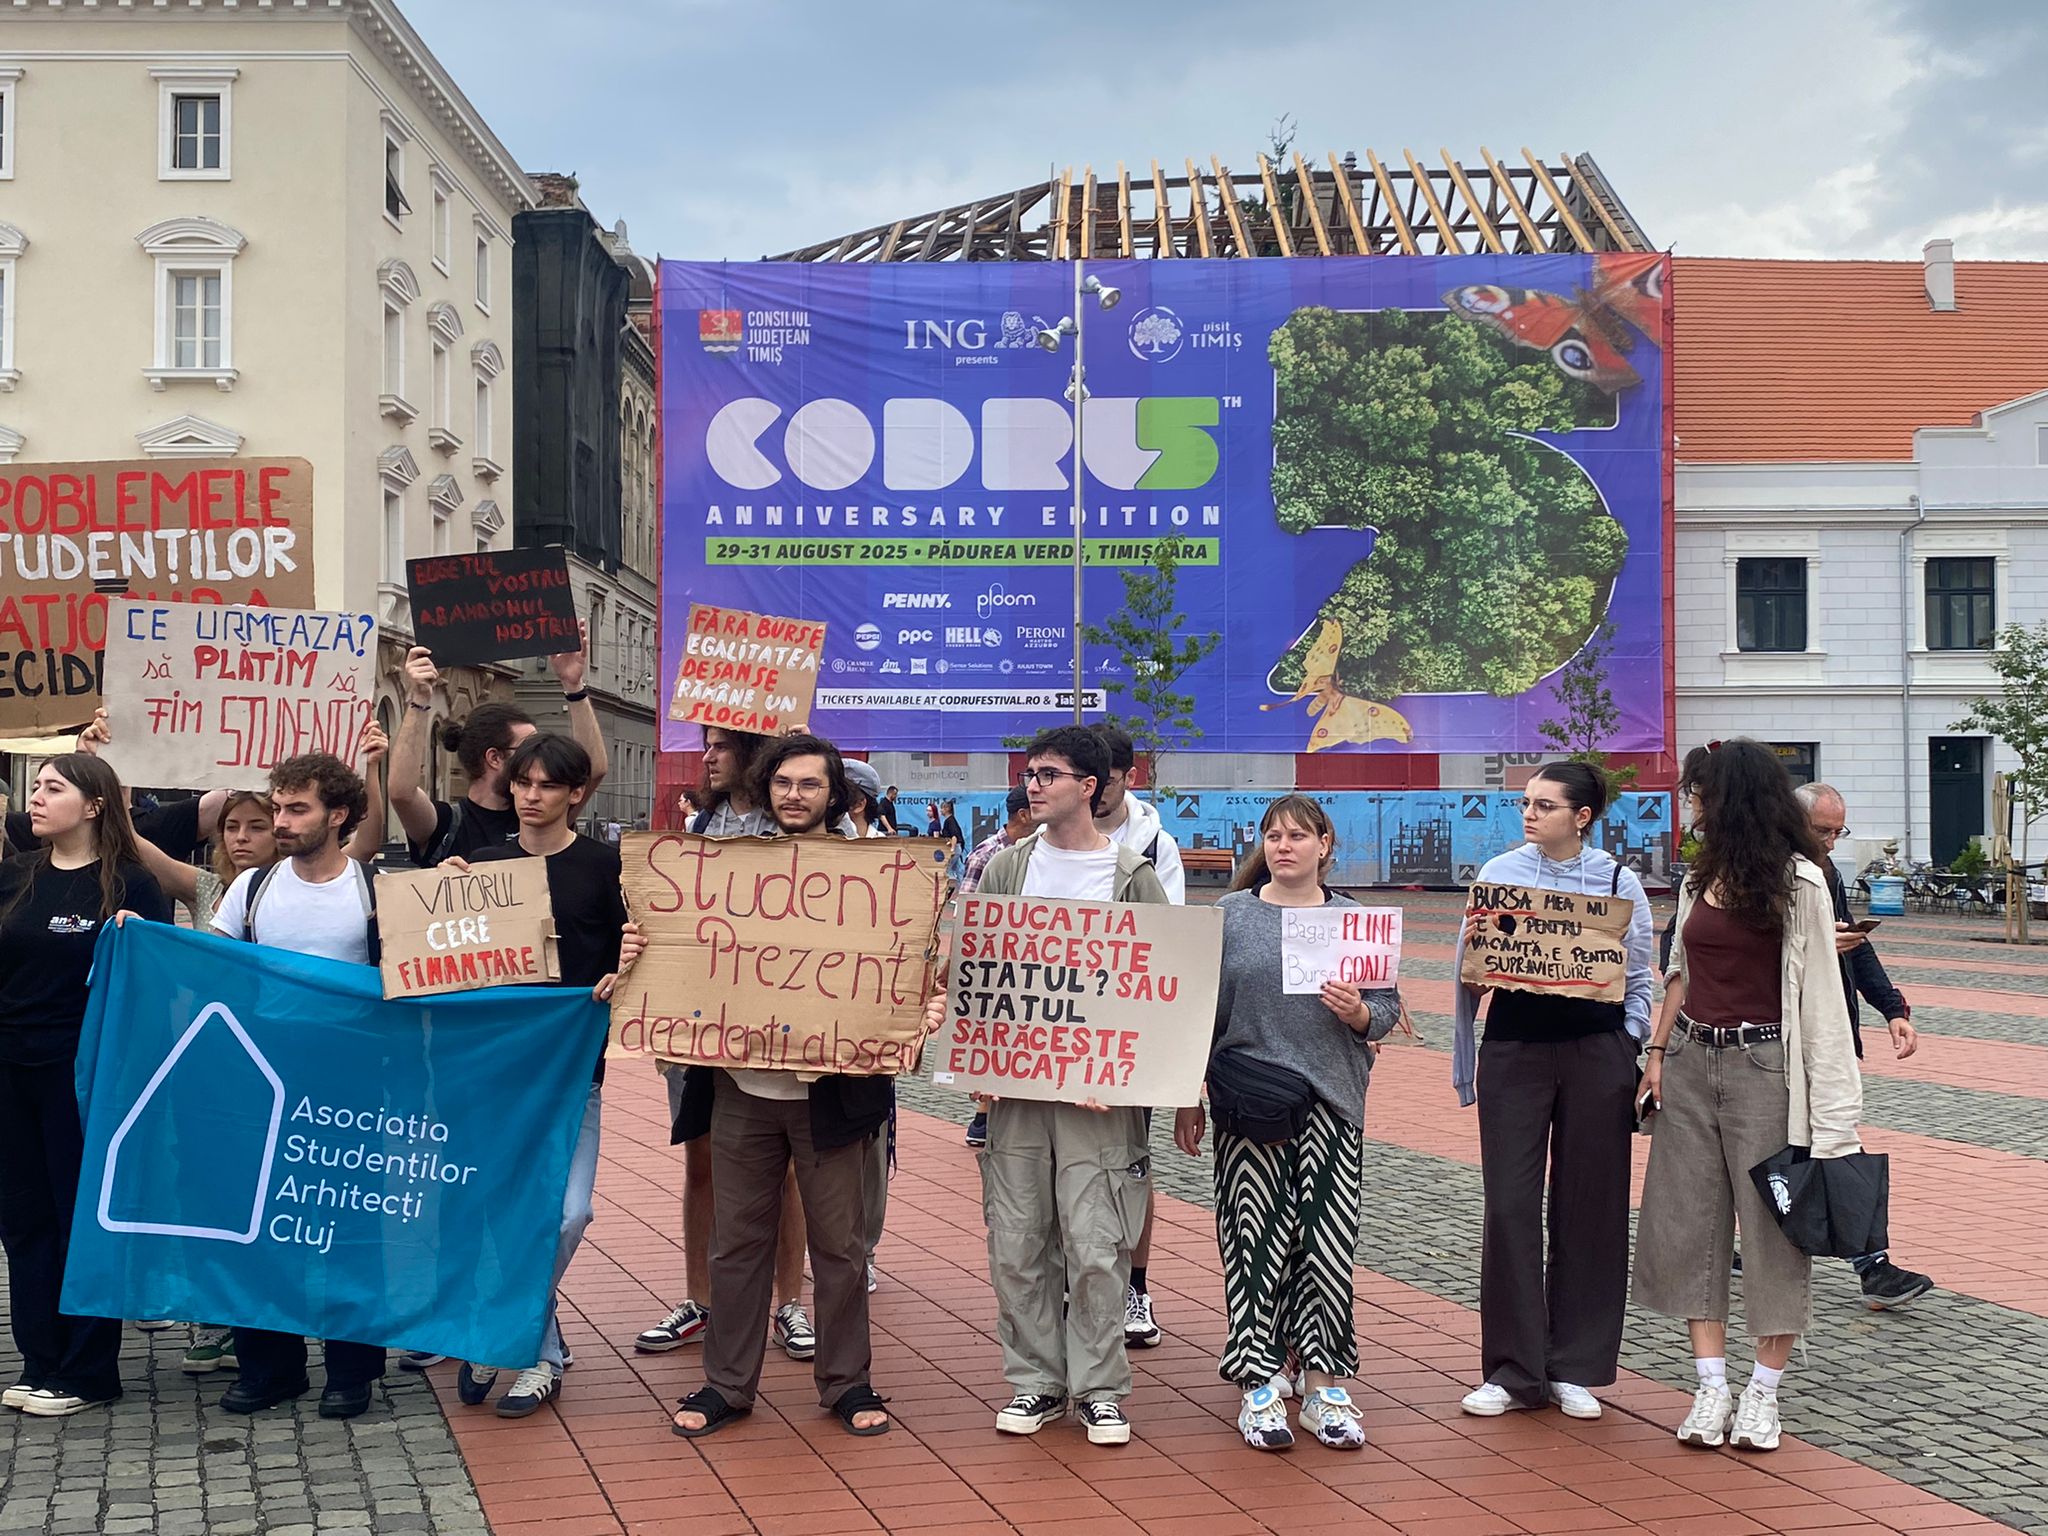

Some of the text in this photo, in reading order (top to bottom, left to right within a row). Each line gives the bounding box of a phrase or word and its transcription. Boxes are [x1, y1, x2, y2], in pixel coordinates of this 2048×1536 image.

[747, 311, 811, 327] CONSILIUL
[1203, 321, 1230, 332] visit
[747, 329, 809, 349] JUDEȚEAN
[904, 319, 987, 349] ING
[1190, 333, 1242, 352] TIMIȘ
[747, 346, 783, 366] TIMIȘ
[955, 355, 998, 366] presents
[1222, 396, 1242, 408] TH
[706, 505, 1219, 526] ANNIVERSARY EDITION
[716, 543, 770, 559] 29-31
[776, 543, 854, 559] AUGUST
[860, 543, 908, 559] 2025
[928, 540, 1016, 559] PĂDUREA
[487, 568, 570, 595] VOSTRU
[420, 598, 551, 627] ABANDONUL
[127, 608, 375, 657] CE URMEAZĂ?
[495, 615, 577, 642] NOSTRU
[693, 607, 824, 649] FĂRĂ BURSE
[856, 632, 880, 641] PEPSI
[898, 629, 933, 645] ppc
[945, 627, 982, 643] HELL
[1016, 626, 1065, 638] PERONI
[686, 633, 816, 672] EGALITATEA
[882, 659, 899, 669] dm
[142, 643, 357, 694] să PLĂTIM să
[682, 658, 710, 680] DE
[677, 679, 798, 713] RĂMÂNE UN
[821, 694, 1092, 706] TICKETS AVAILABLE AT CODRUFESTIVAL.RO & iabet
[145, 691, 202, 735] FIM
[685, 702, 779, 732] SLOGAN
[880, 797, 943, 805] STRUCTIM
[411, 872, 523, 915] VIITORUL
[1471, 885, 1608, 916] BURSA MEA NU
[426, 915, 491, 951] CERE
[963, 900, 1137, 938] EDUCAȚIA
[1287, 912, 1397, 947] Bagaje PLINE
[1524, 916, 1583, 937] PENTRU
[961, 932, 1152, 977] SĂRĂCEȘTE
[1485, 955, 1593, 981] SUPRAVIEȚUIRE
[1552, 947, 1562, 961] E
[1571, 947, 1623, 965] PENTRU
[1287, 954, 1394, 986] Burse GOALE
[1116, 972, 1178, 1002] SAU
[954, 990, 1087, 1024] STATUL
[948, 1048, 1136, 1090] EDUCAȚIA?
[291, 1095, 449, 1145] Asociația
[284, 1135, 478, 1185] Studenților
[276, 1175, 423, 1224] Arhitecți
[269, 1214, 337, 1255] Cluj
